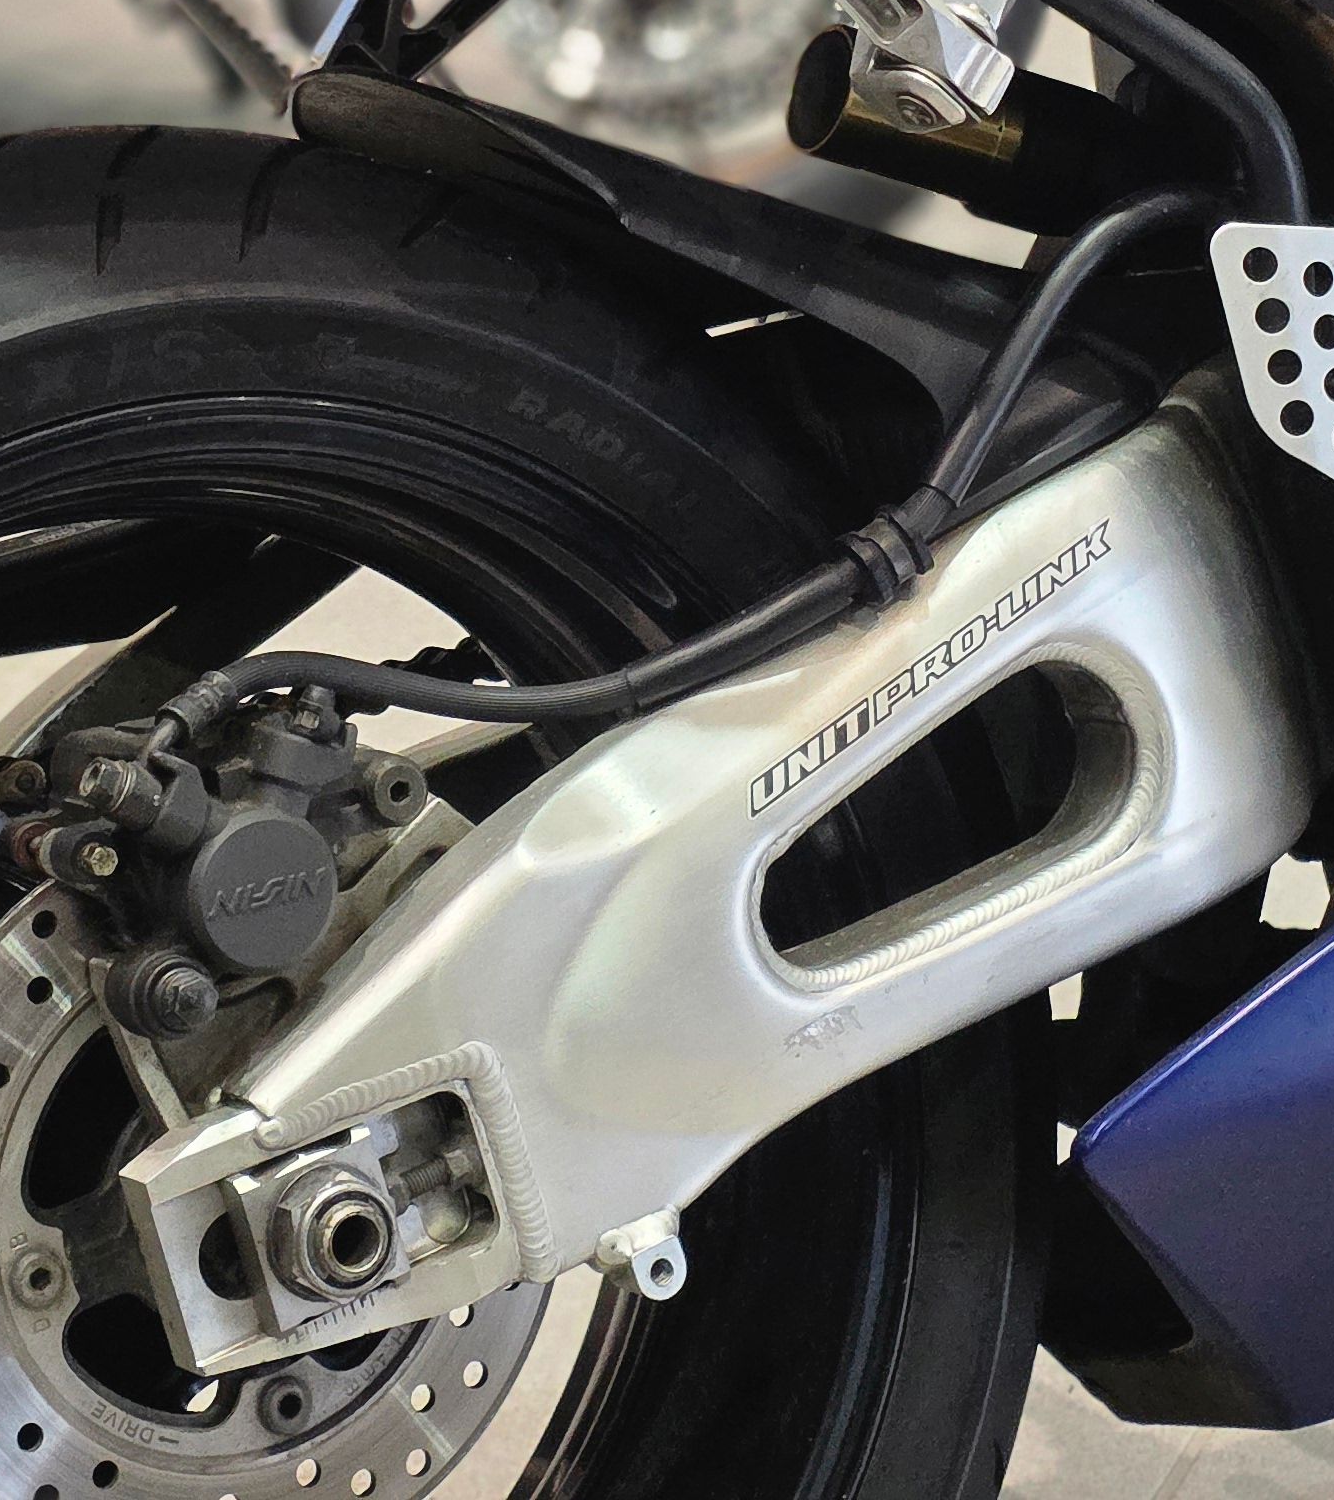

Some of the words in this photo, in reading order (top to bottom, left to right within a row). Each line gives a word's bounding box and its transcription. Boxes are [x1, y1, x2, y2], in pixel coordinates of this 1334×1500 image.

[748, 693, 873, 819] UNIT
[872, 518, 1111, 737] PRO-LINK
[89, 1400, 156, 1445] DRIVE
